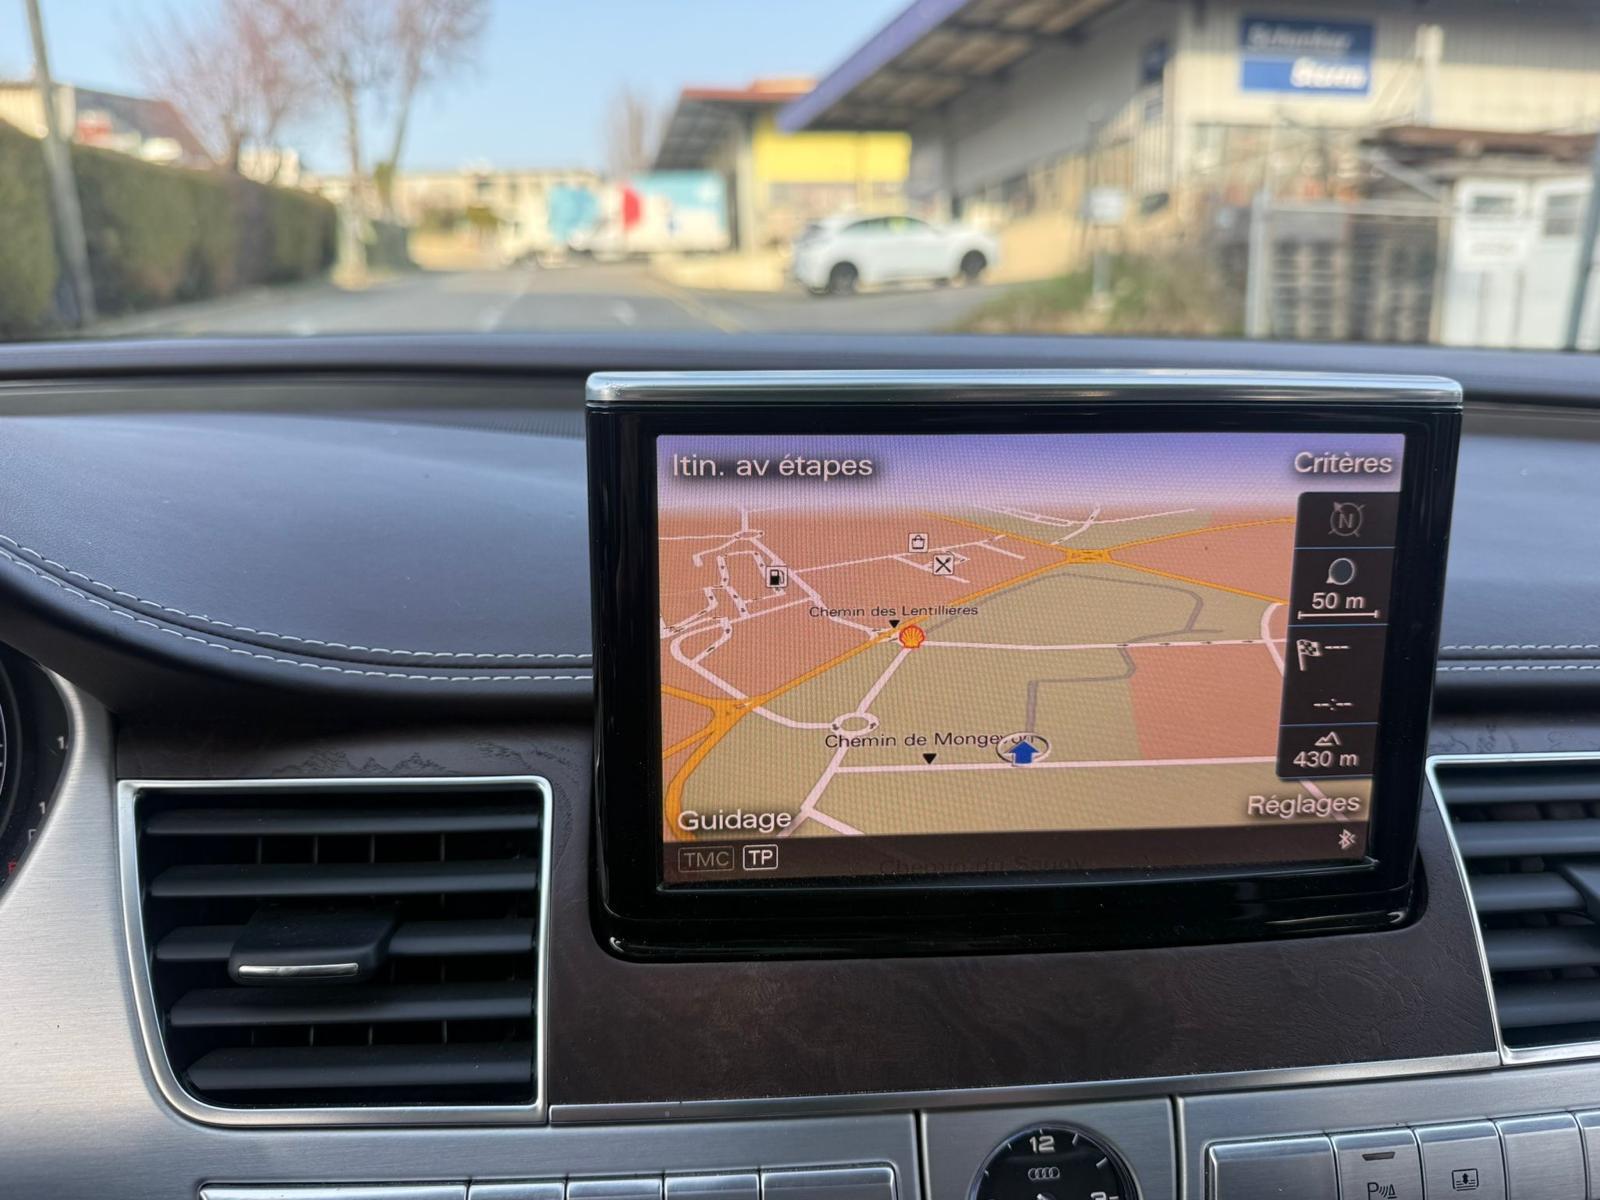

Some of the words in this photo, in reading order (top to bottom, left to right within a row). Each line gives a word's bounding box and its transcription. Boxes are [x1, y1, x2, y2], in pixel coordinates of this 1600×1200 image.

[673, 454, 724, 476] Itin.
[736, 459, 770, 476] av
[778, 453, 873, 482] étapes
[1294, 451, 1393, 473] Critères
[1311, 592, 1338, 610] 50
[1345, 595, 1365, 609] m
[809, 606, 865, 618] Chemin
[870, 606, 896, 616] des
[825, 734, 896, 749] Chemin
[904, 733, 928, 747] de
[1293, 750, 1332, 768] 430
[1339, 753, 1358, 767] m
[1247, 794, 1361, 819] Réglages
[677, 808, 792, 834] Guidage
[683, 852, 730, 868] TMC
[748, 849, 773, 866] TP
[1029, 1135, 1055, 1153] 12
